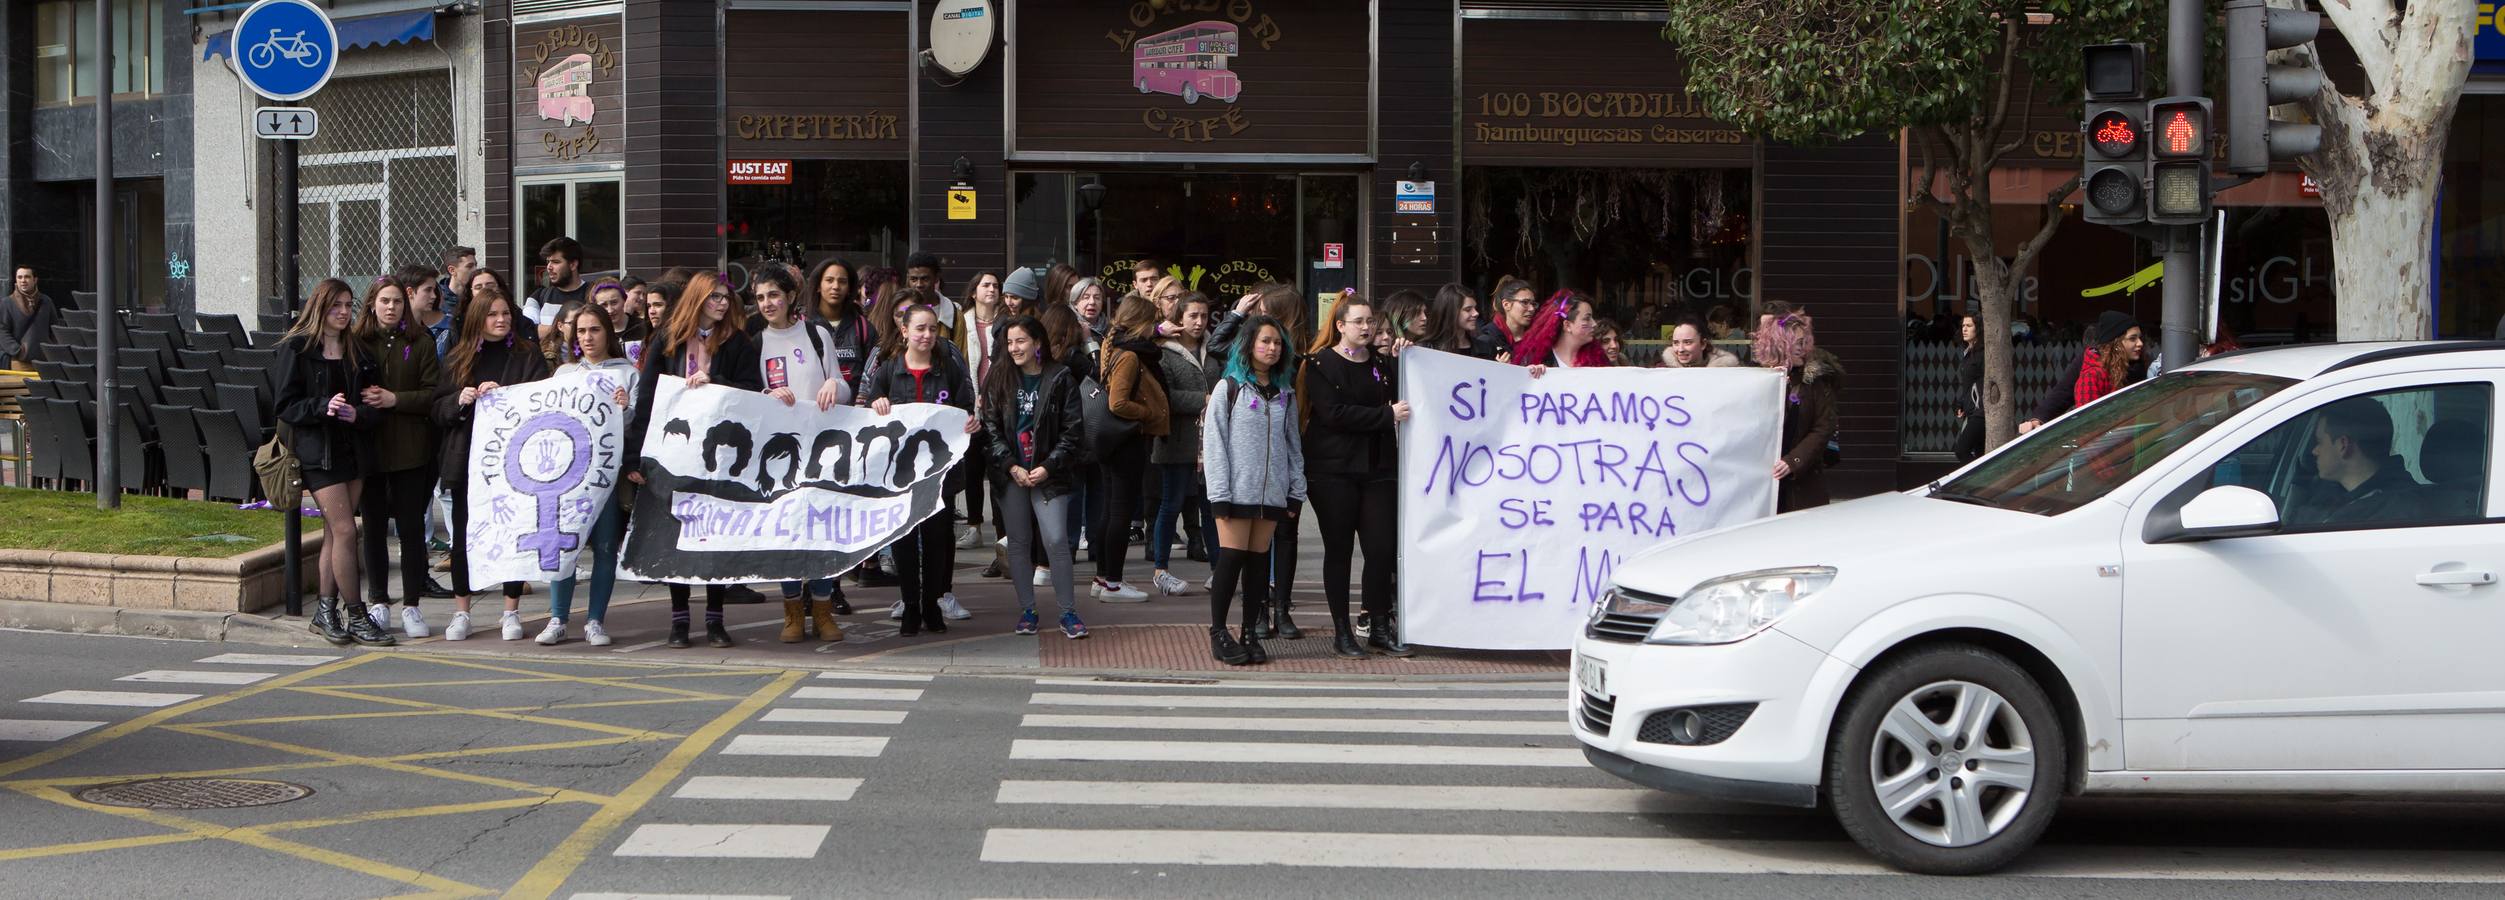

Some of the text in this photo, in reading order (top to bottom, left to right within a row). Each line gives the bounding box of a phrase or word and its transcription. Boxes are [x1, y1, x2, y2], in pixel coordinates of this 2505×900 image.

[523, 24, 615, 86] LONDON
[1478, 92, 1713, 118] 100 BOCADILL
[737, 110, 898, 139] CAFETERÍA
[1650, 124, 1742, 144] Caseras
[730, 163, 788, 174] JUST EAT
[1399, 203, 1432, 211] 24 HORAS
[1219, 283, 1252, 296] CAF
[1521, 391, 1692, 431] PARAMOS
[480, 405, 522, 486] TODAS
[528, 386, 613, 428] SOMOS
[1424, 435, 1711, 507] NOSOTRAS
[806, 503, 905, 545] MUJER
[1500, 498, 1676, 536] SE PARA
[1472, 549, 1545, 602] EL
